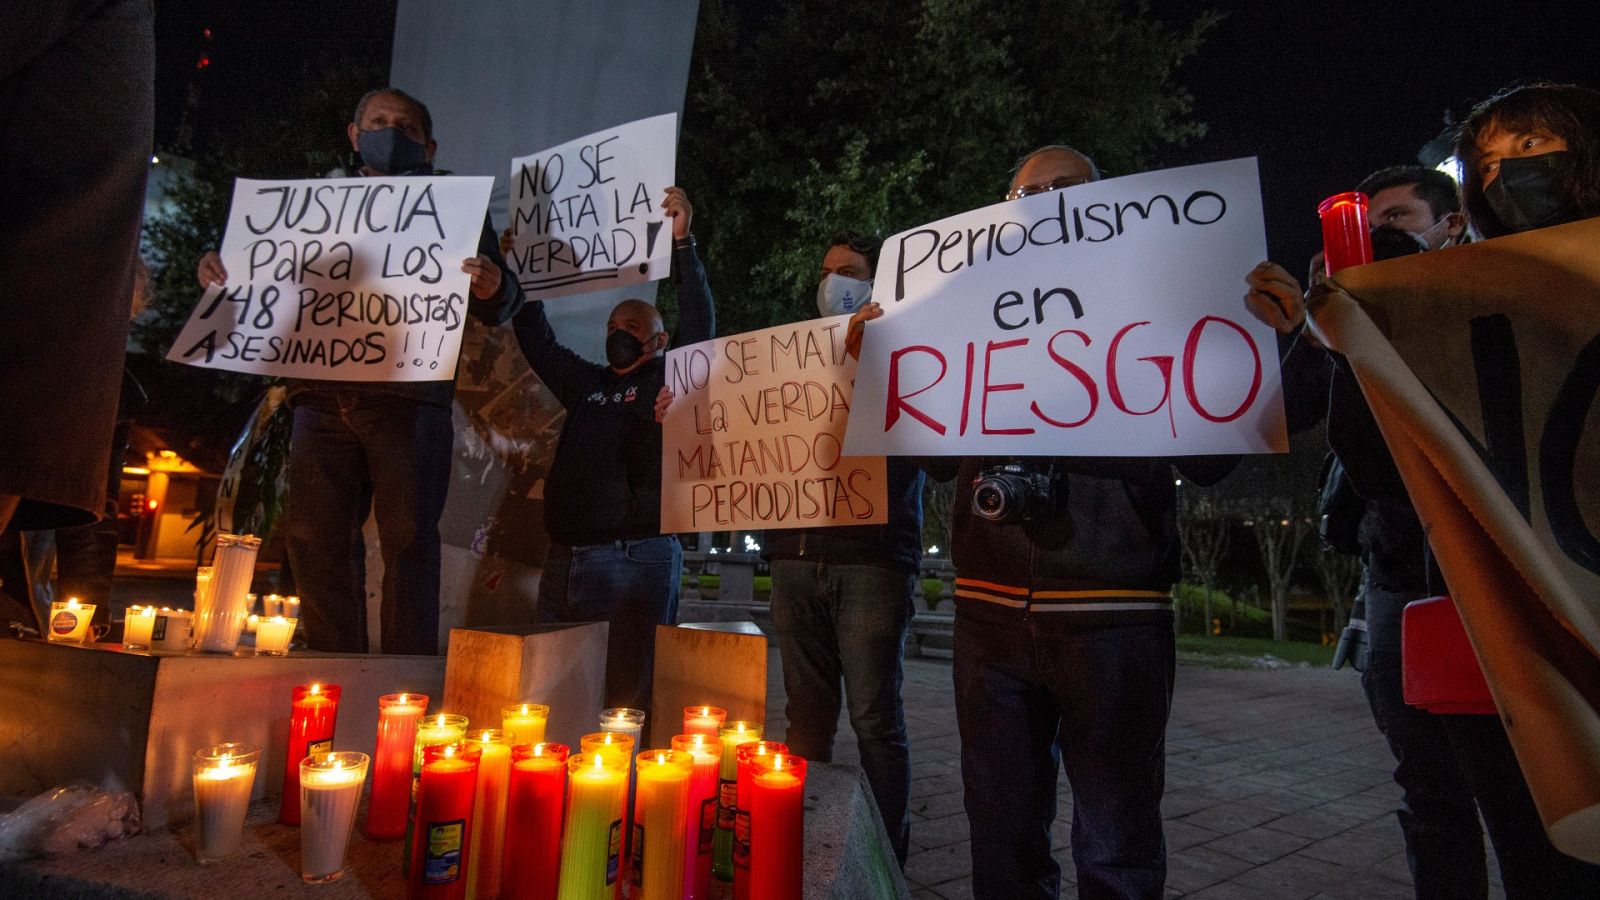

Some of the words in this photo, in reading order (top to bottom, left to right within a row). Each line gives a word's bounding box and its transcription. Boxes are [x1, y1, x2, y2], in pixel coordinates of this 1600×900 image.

[520, 153, 564, 199] NO
[577, 135, 620, 189] SE
[245, 183, 446, 240] JUSTICIA
[514, 194, 599, 236] MATA
[614, 182, 652, 224] LA
[381, 242, 443, 284] LOS
[895, 190, 1227, 302] Periodismo
[201, 285, 280, 330] 148
[993, 286, 1085, 331] en
[183, 329, 386, 368] ASESINADOS
[672, 349, 711, 398] NO
[724, 337, 760, 384] SE
[770, 322, 848, 373] MAT
[741, 379, 855, 426] VERDA
[884, 315, 1263, 438] RIESGO
[677, 432, 842, 480] MATANDO
[692, 469, 874, 528] PERIODISTAS
